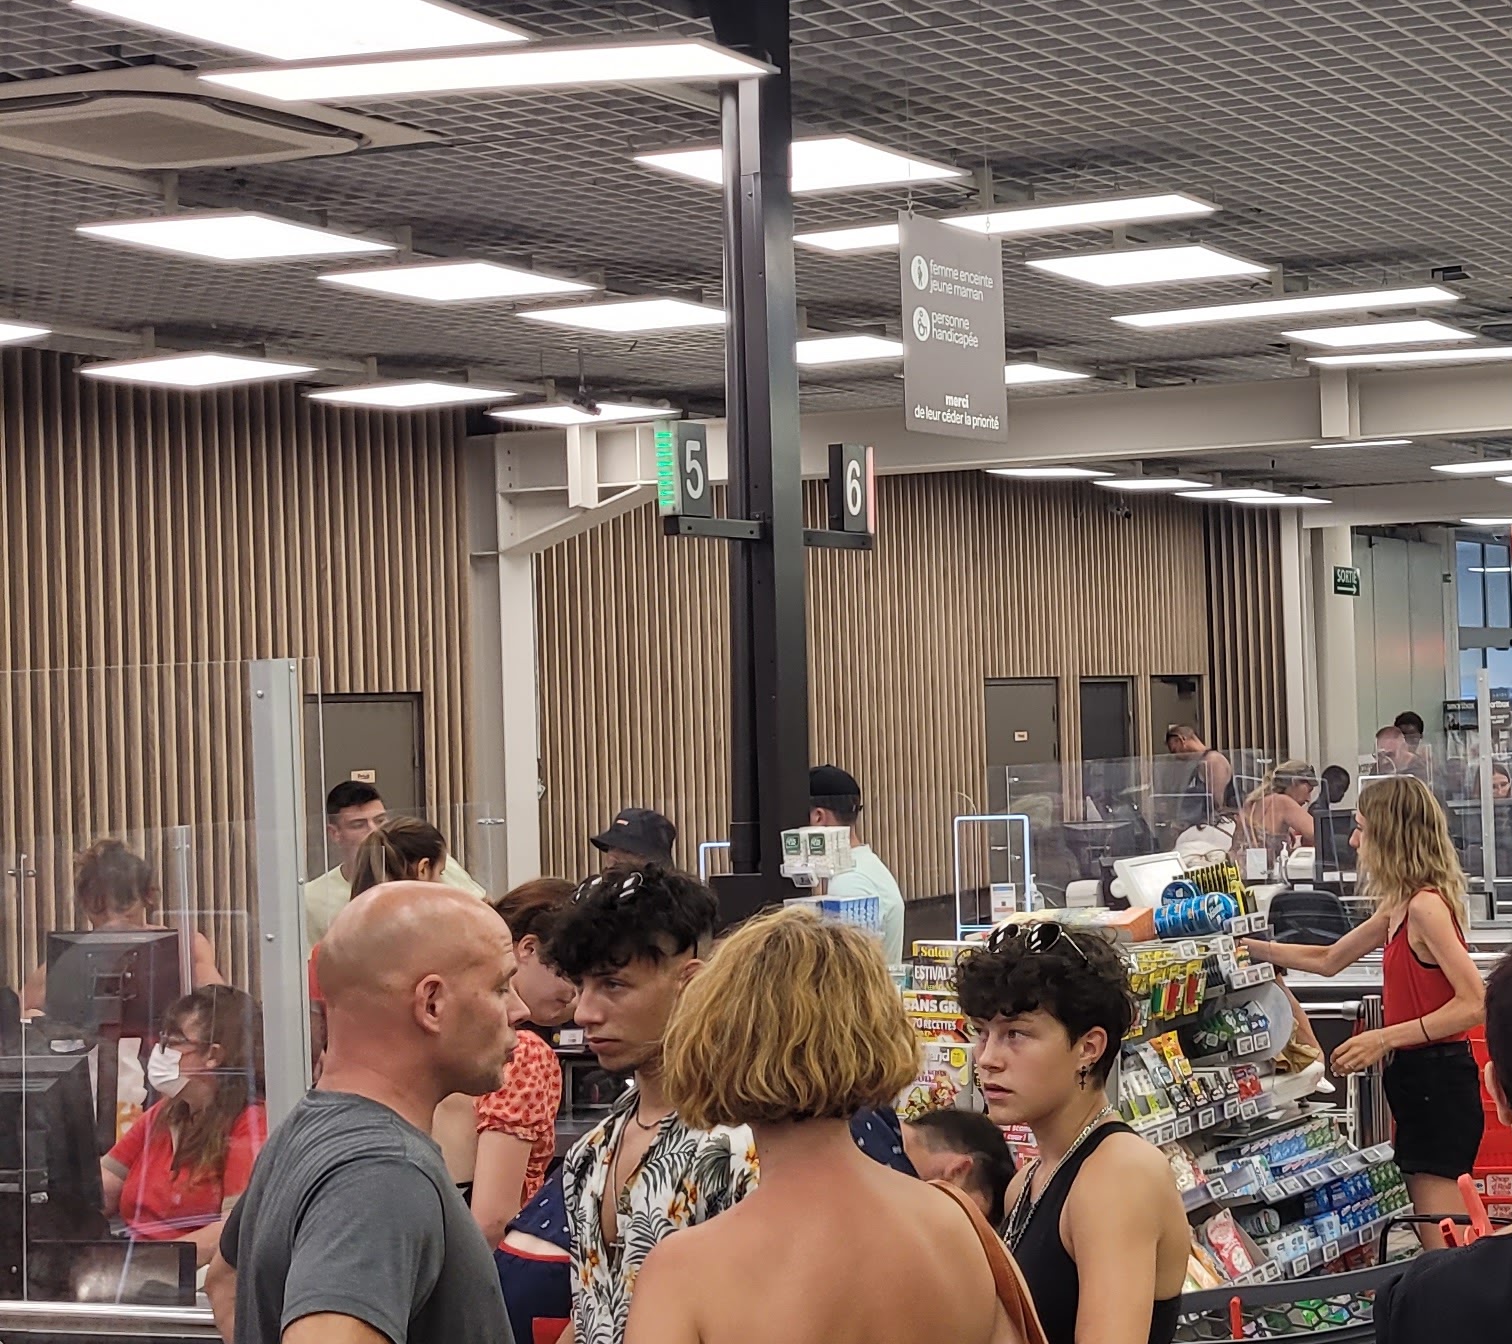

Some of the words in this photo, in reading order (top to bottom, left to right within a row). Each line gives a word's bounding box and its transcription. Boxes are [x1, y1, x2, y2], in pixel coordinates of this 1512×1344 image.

[930, 259, 959, 280] femme
[960, 269, 994, 288] enceinte
[929, 279, 953, 294] jeune
[954, 284, 984, 302] maman
[931, 311, 970, 330] personne
[932, 327, 979, 349] handicapée
[945, 394, 969, 409] merci
[914, 404, 925, 418] de
[925, 405, 941, 421] leur
[941, 408, 964, 424] céder
[964, 411, 972, 426] la
[972, 413, 1000, 430] priorité
[685, 440, 704, 500] 5
[846, 459, 862, 516] 6
[1336, 568, 1357, 585] SORTIE
